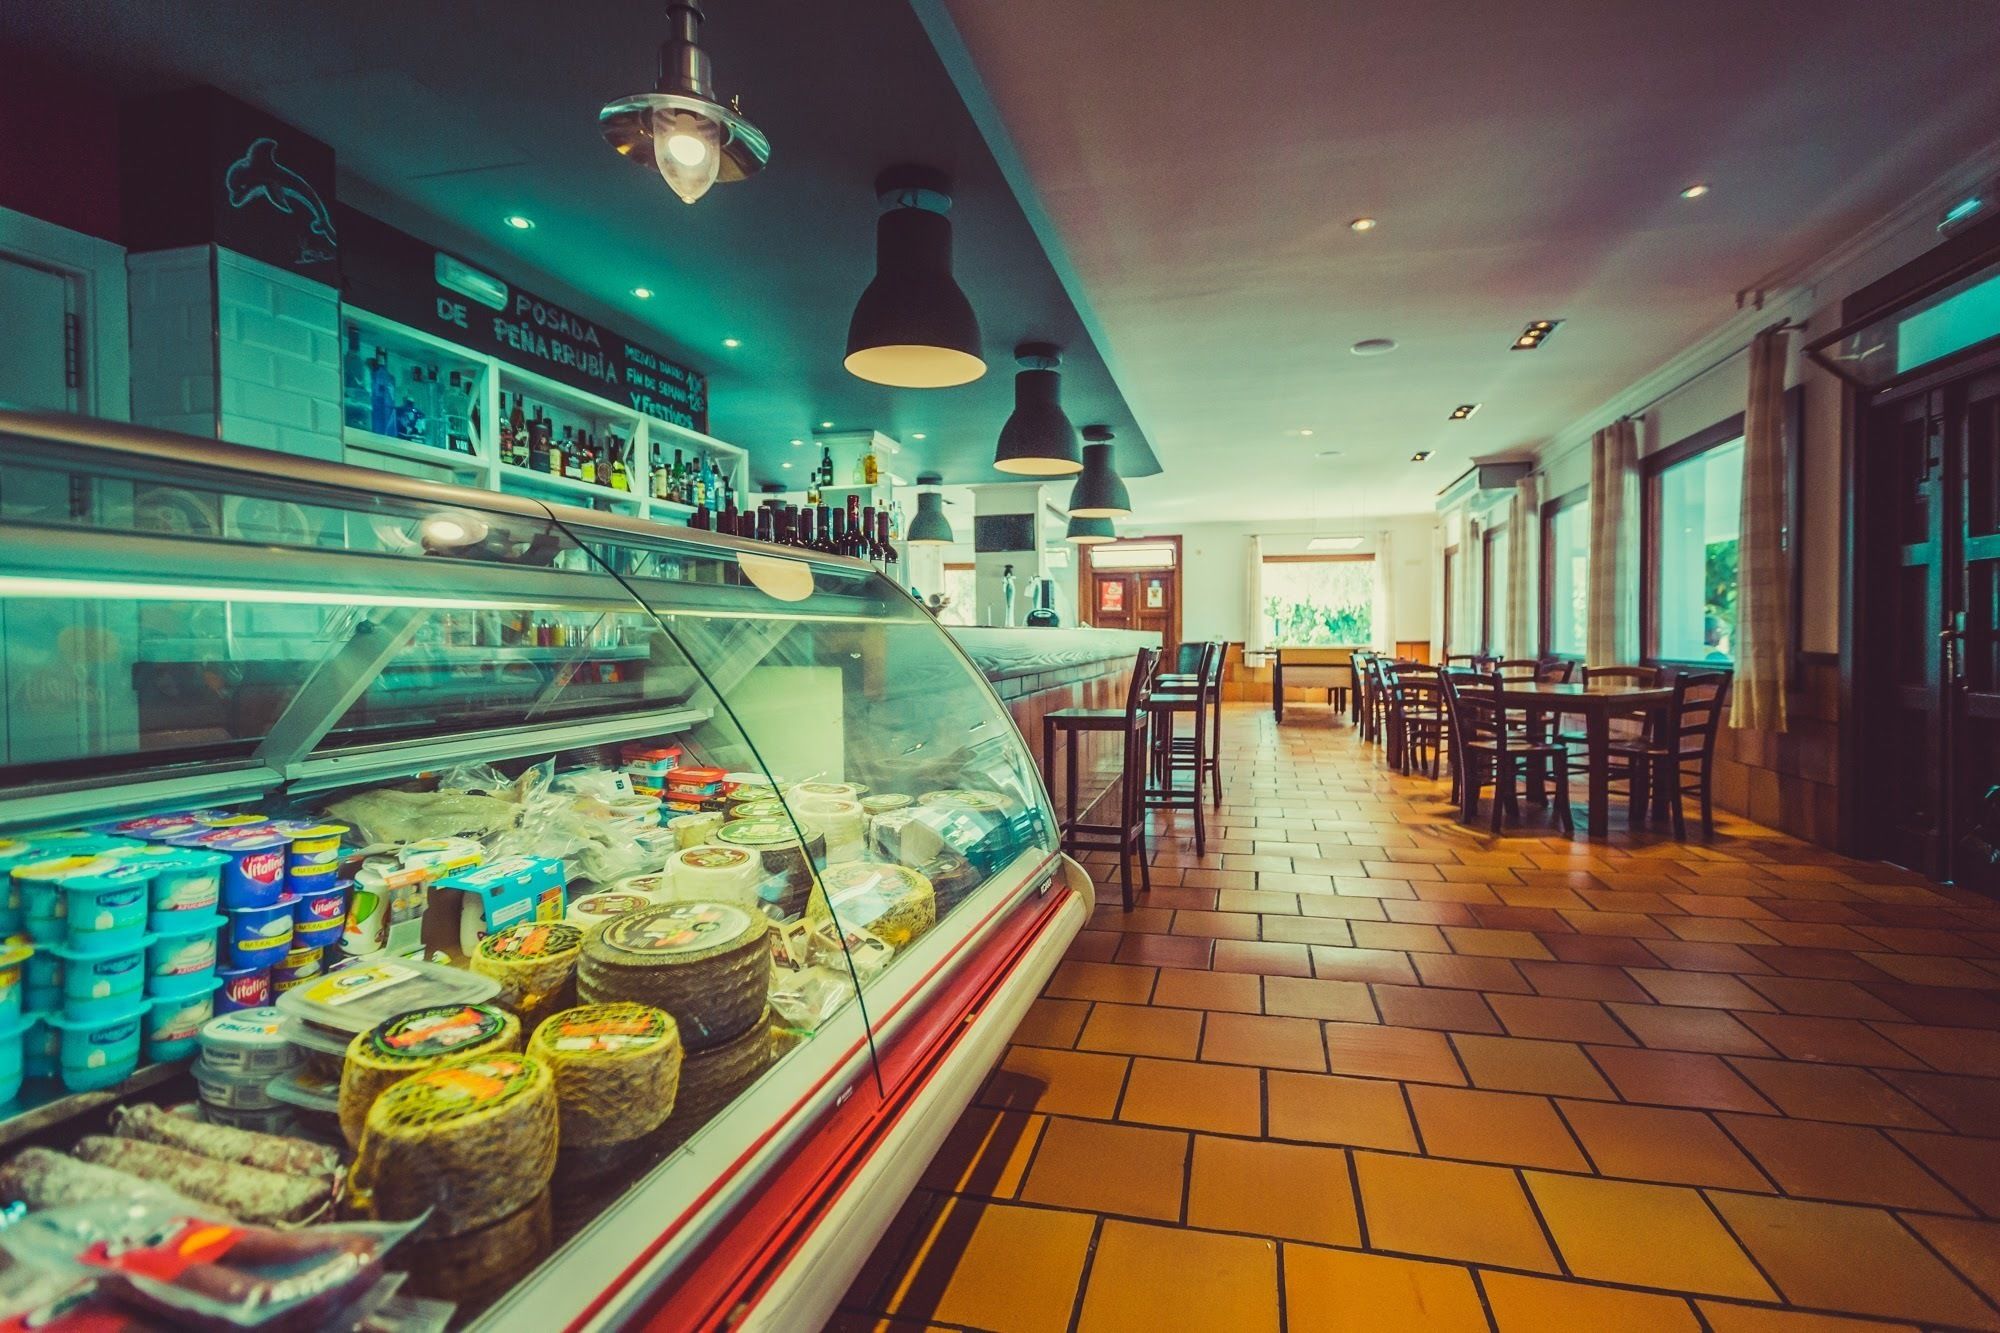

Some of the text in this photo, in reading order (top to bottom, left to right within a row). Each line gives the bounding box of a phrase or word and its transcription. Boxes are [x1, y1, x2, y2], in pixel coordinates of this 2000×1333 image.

[437, 297, 468, 329] DE
[516, 294, 601, 348] POSADA
[644, 374, 656, 391] DE
[630, 391, 641, 412] Y
